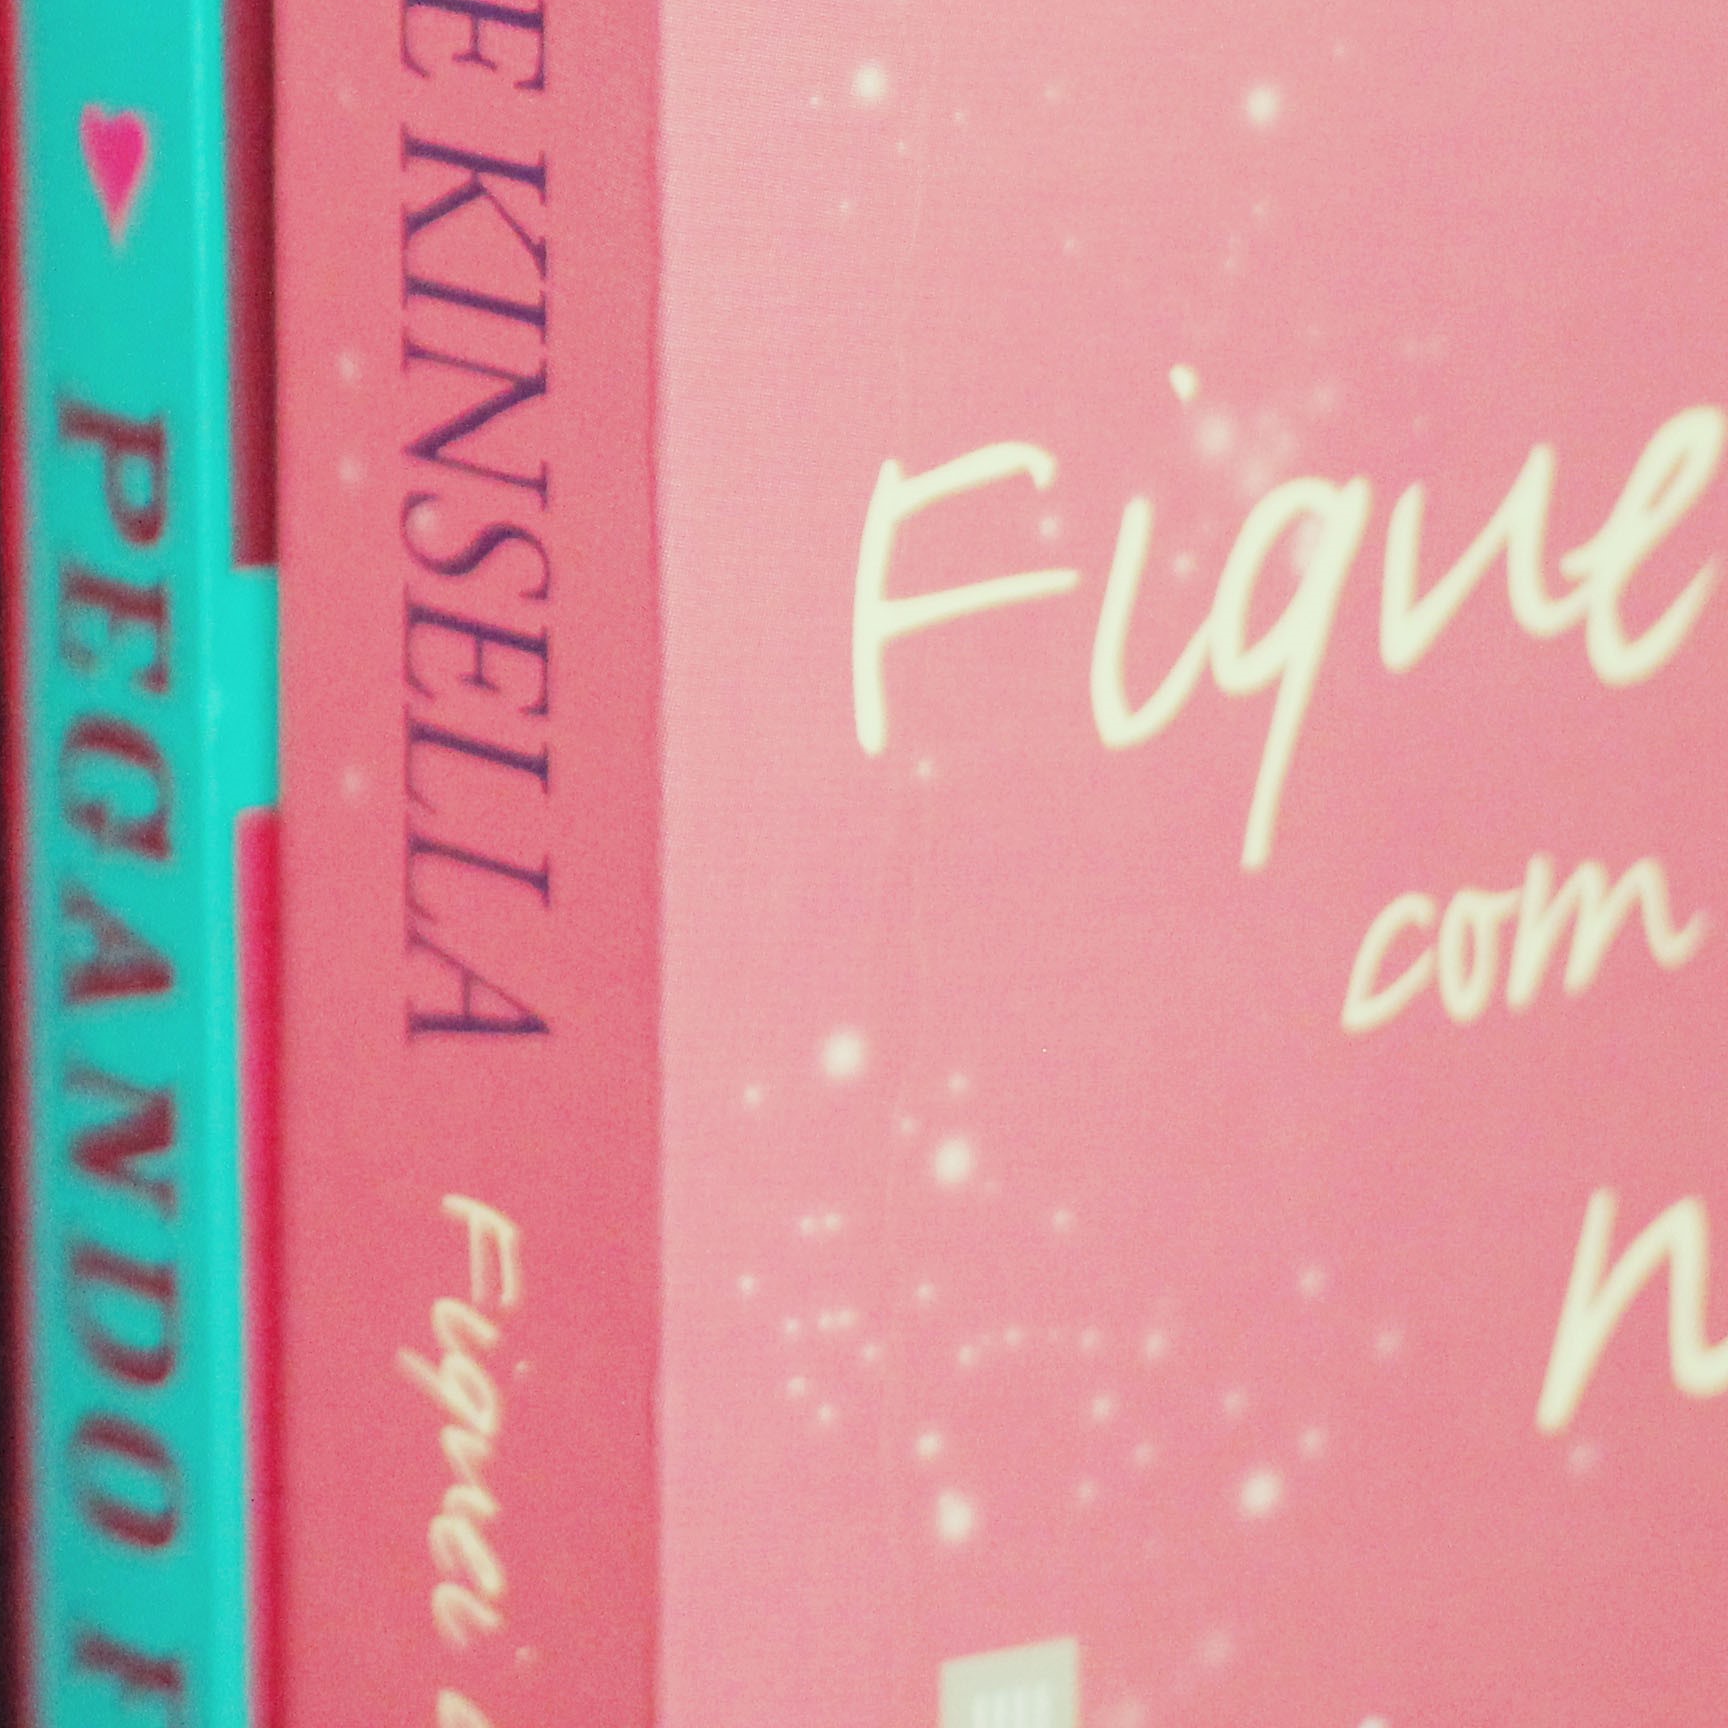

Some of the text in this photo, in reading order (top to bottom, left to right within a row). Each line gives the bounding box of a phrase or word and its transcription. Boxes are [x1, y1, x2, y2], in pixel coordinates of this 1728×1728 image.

[56, 394, 177, 1556] PEGANDO
[397, 124, 550, 1047] KINSELLA
[1340, 852, 1712, 1033] com
